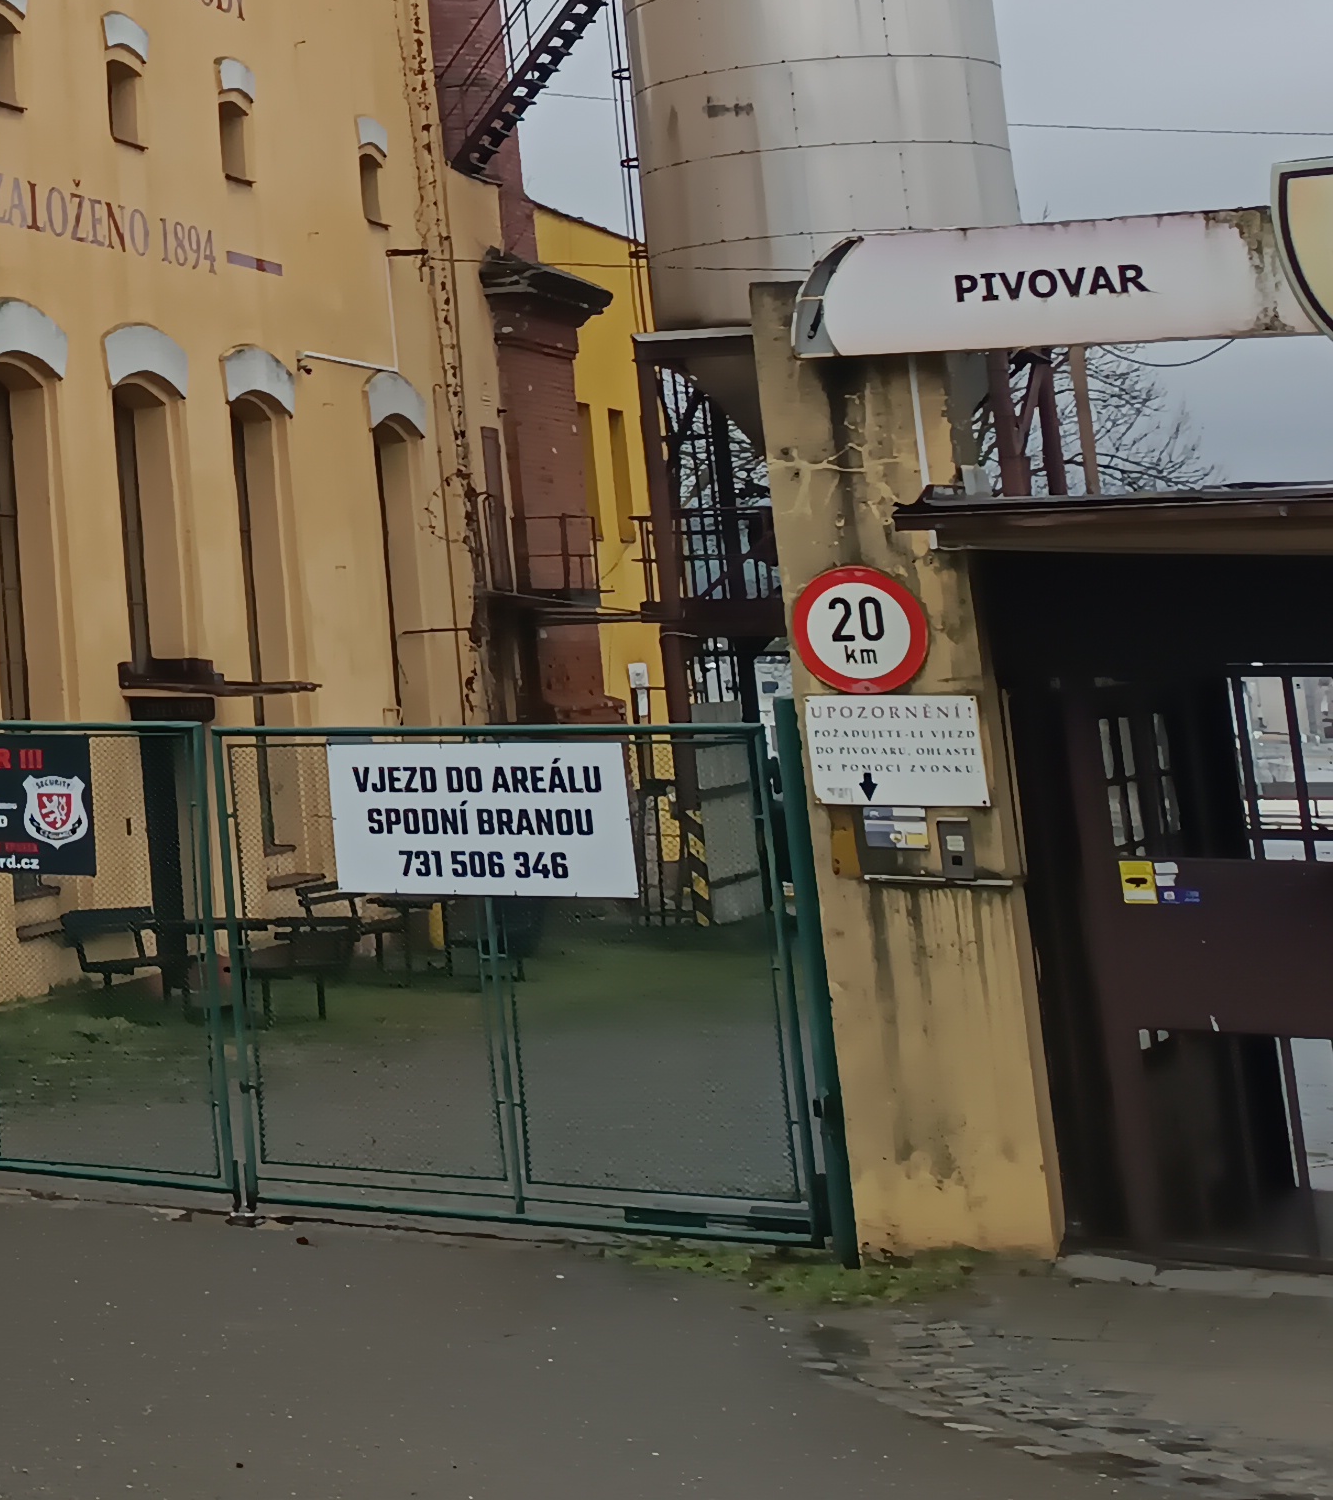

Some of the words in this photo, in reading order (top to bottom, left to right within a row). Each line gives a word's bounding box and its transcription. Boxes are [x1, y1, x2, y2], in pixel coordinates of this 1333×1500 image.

[159, 217, 218, 275] 1894
[954, 263, 1154, 303] PIVOVAR
[828, 596, 885, 642] 20
[844, 645, 878, 665] km
[930, 729, 975, 739] VJEZD
[816, 746, 834, 755] DO
[36, 779, 71, 789] SECURITY
[352, 766, 438, 793] VJEZD
[445, 766, 483, 793] DO
[491, 758, 602, 793] AREÁLU
[367, 800, 469, 835] SPODNÍ
[476, 808, 594, 835] BRANOU
[398, 850, 443, 877] 731
[451, 851, 506, 878] 506
[513, 851, 569, 879] 346
